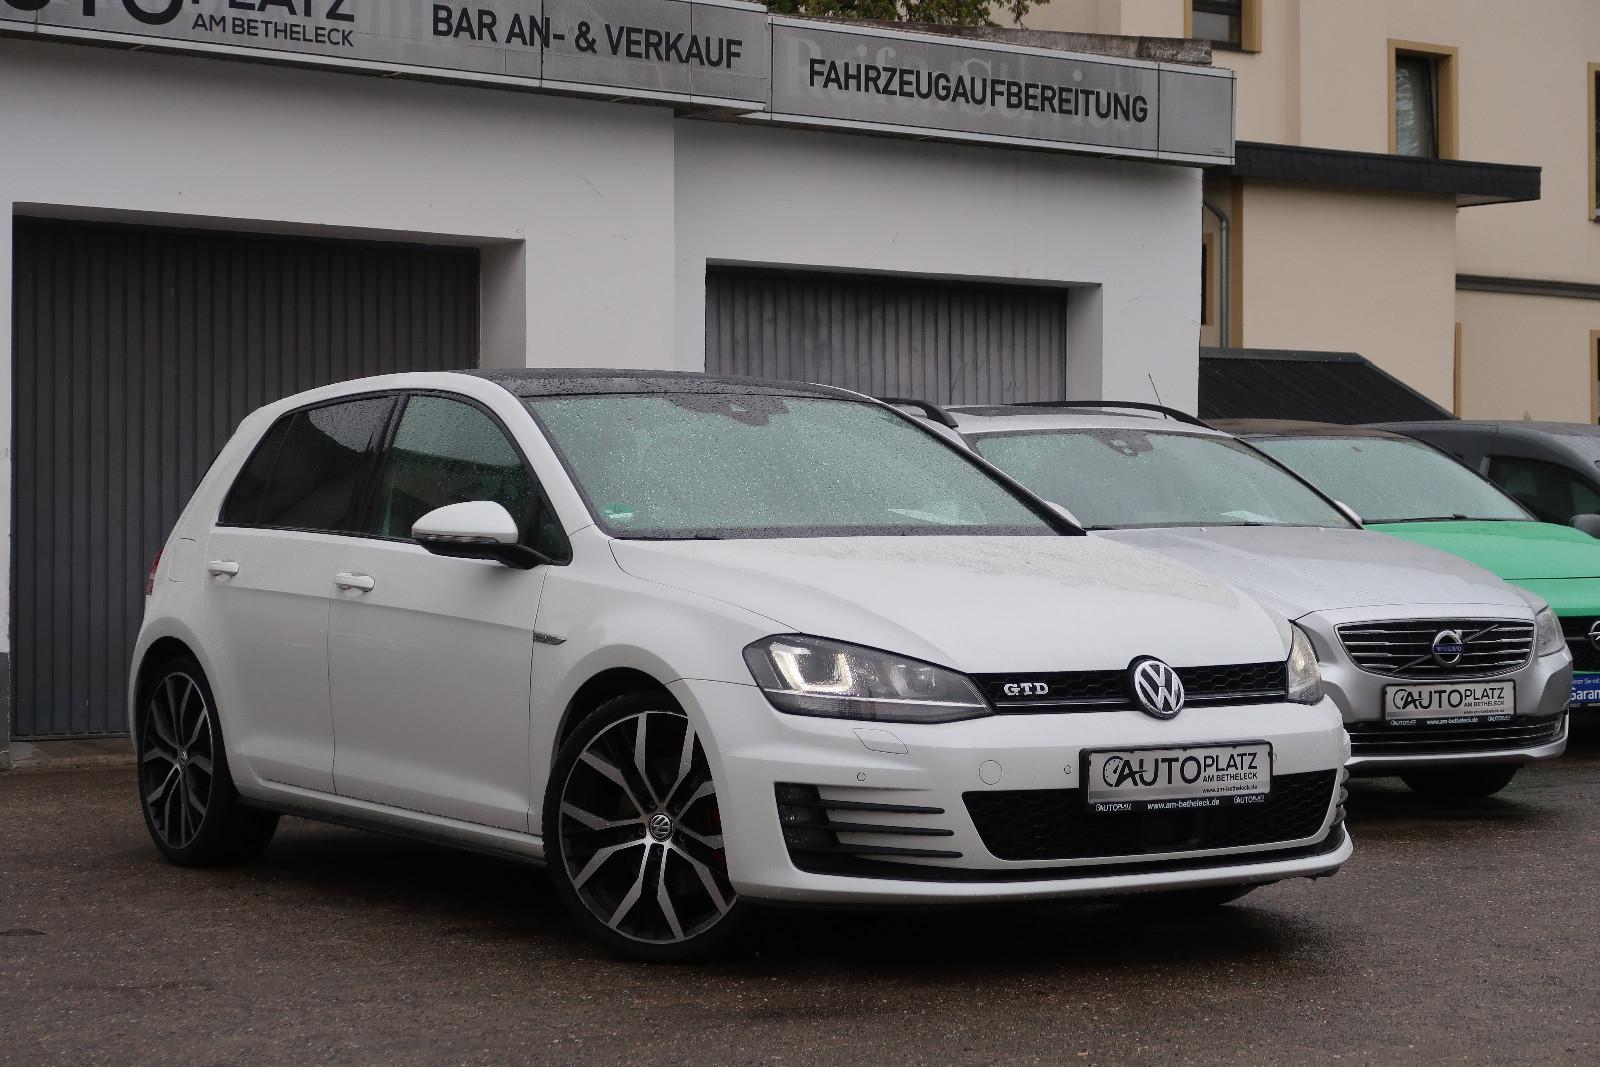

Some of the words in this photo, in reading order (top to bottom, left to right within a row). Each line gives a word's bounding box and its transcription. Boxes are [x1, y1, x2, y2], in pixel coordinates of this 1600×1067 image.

[192, 13, 226, 33] AM
[232, 17, 354, 47] BETHELECK
[433, 4, 498, 43] BAR
[505, 13, 565, 48] AN-
[575, 21, 597, 53] &
[604, 24, 743, 69] VERKAUF
[809, 58, 1148, 123] FAHRZEUGAUFBEREITUNG
[1003, 682, 1049, 696] GTD
[1203, 774, 1215, 783] AM
[1216, 772, 1258, 782] BETHELECK
